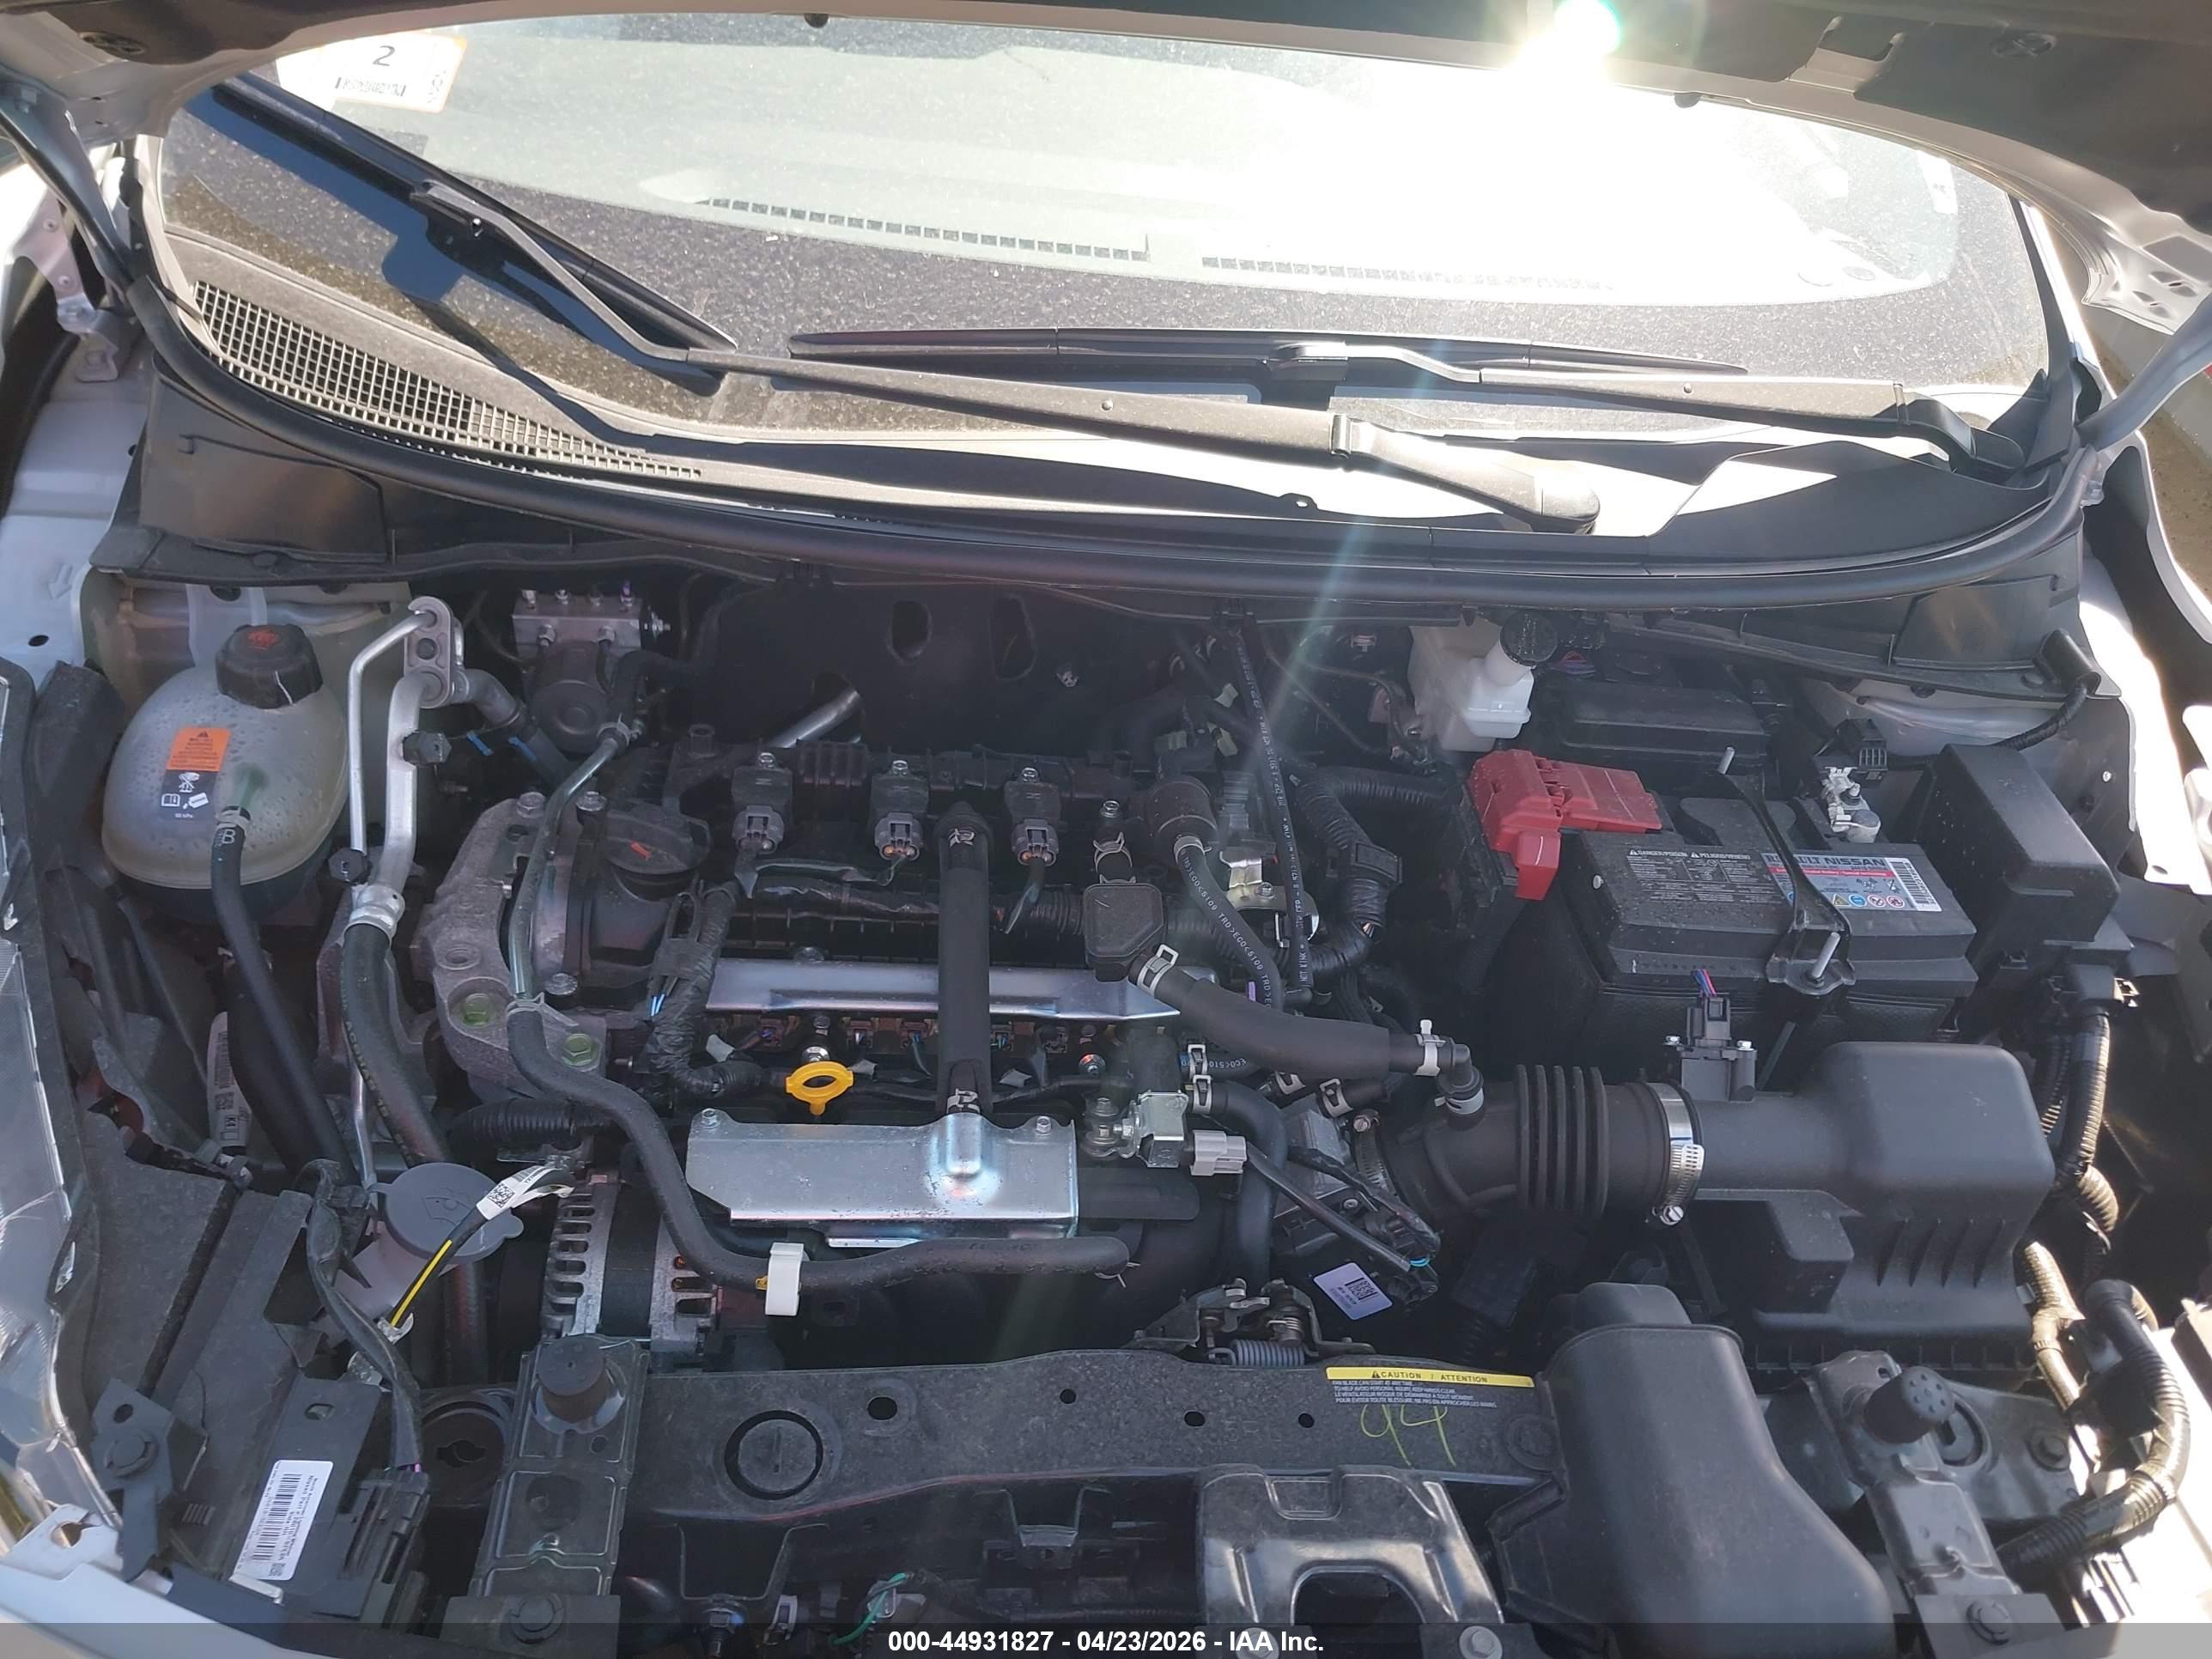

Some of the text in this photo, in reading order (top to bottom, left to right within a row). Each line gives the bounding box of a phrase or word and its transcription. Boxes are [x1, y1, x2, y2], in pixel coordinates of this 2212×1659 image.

[373, 46, 396, 66] 2
[1823, 857, 1886, 866] NISSAN
[1441, 1374, 1488, 1382] ATTENTION
